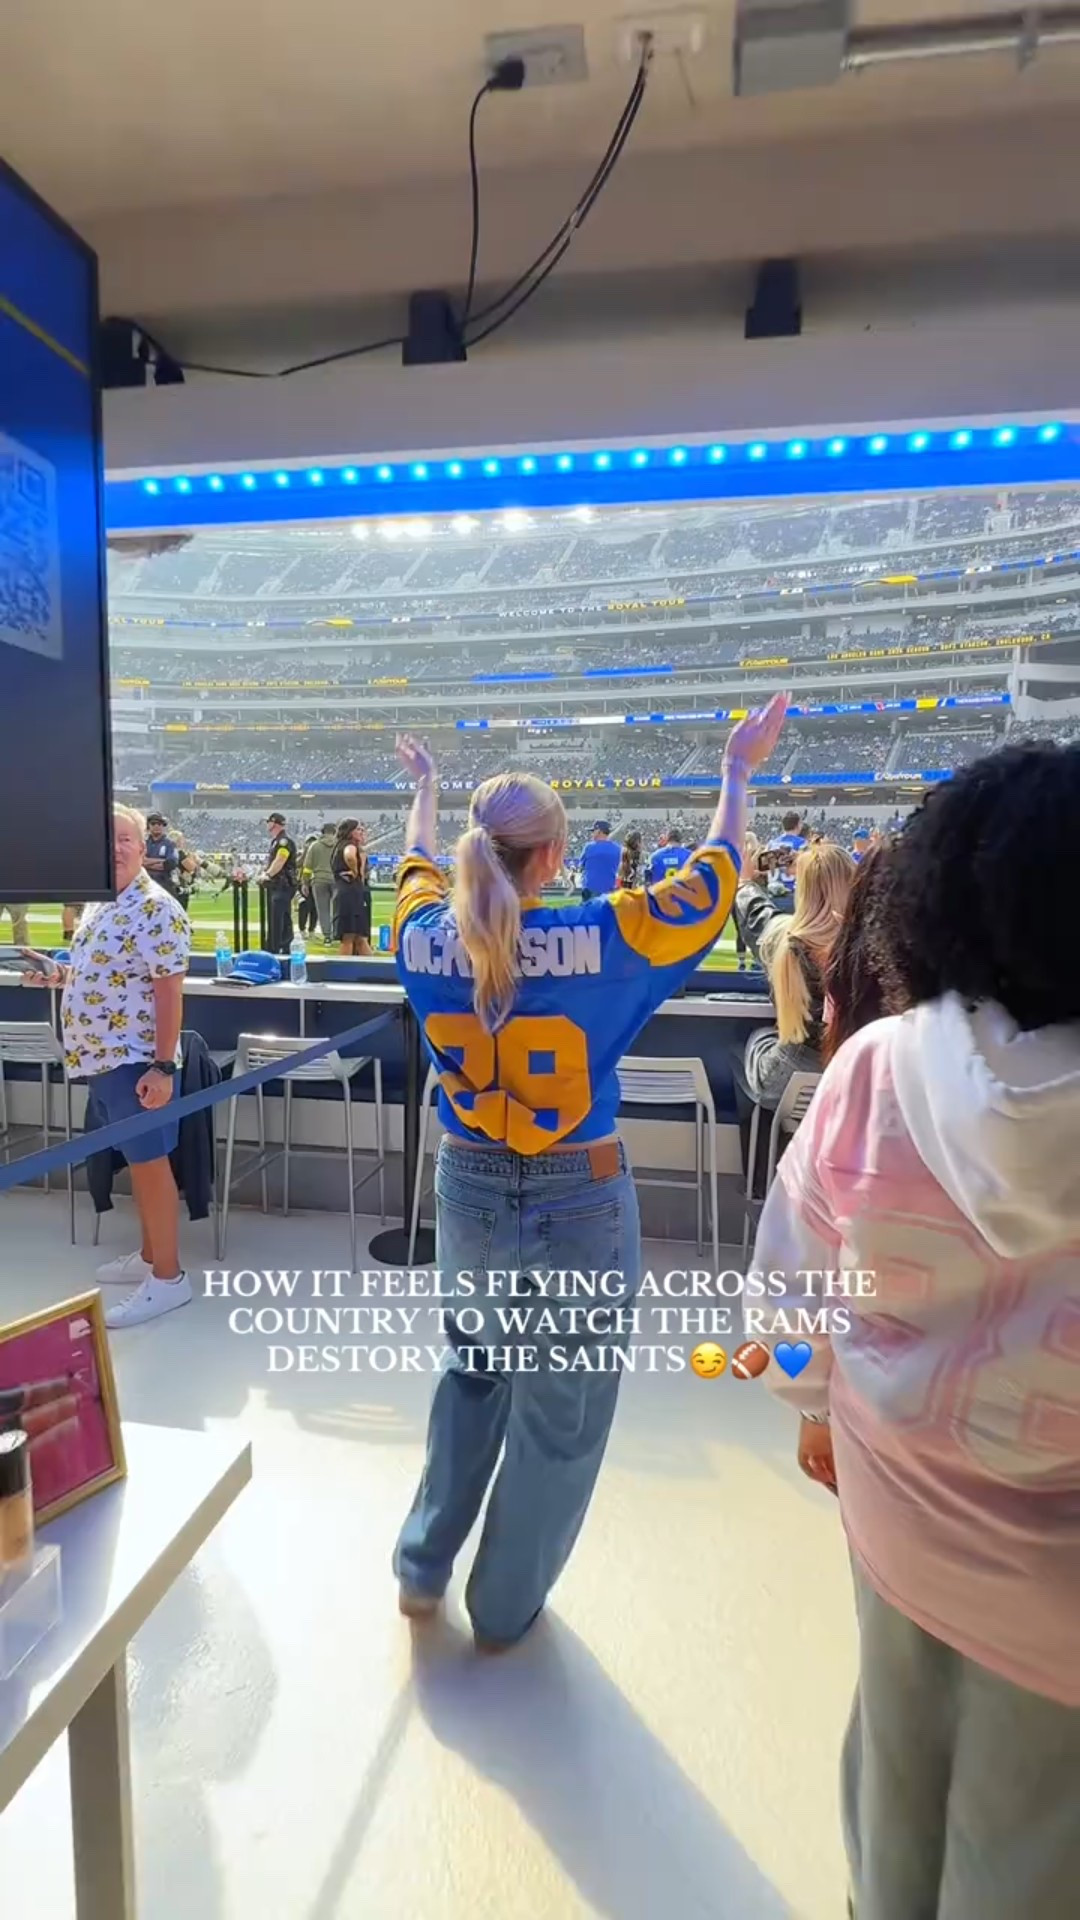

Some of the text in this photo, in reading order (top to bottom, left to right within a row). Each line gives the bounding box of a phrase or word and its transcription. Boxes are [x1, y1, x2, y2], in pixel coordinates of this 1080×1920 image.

[394, 780, 475, 791] WEOME
[550, 778, 663, 789] ROYAL TOUR
[402, 924, 600, 978] DICKSON
[425, 1013, 591, 1155] 29
